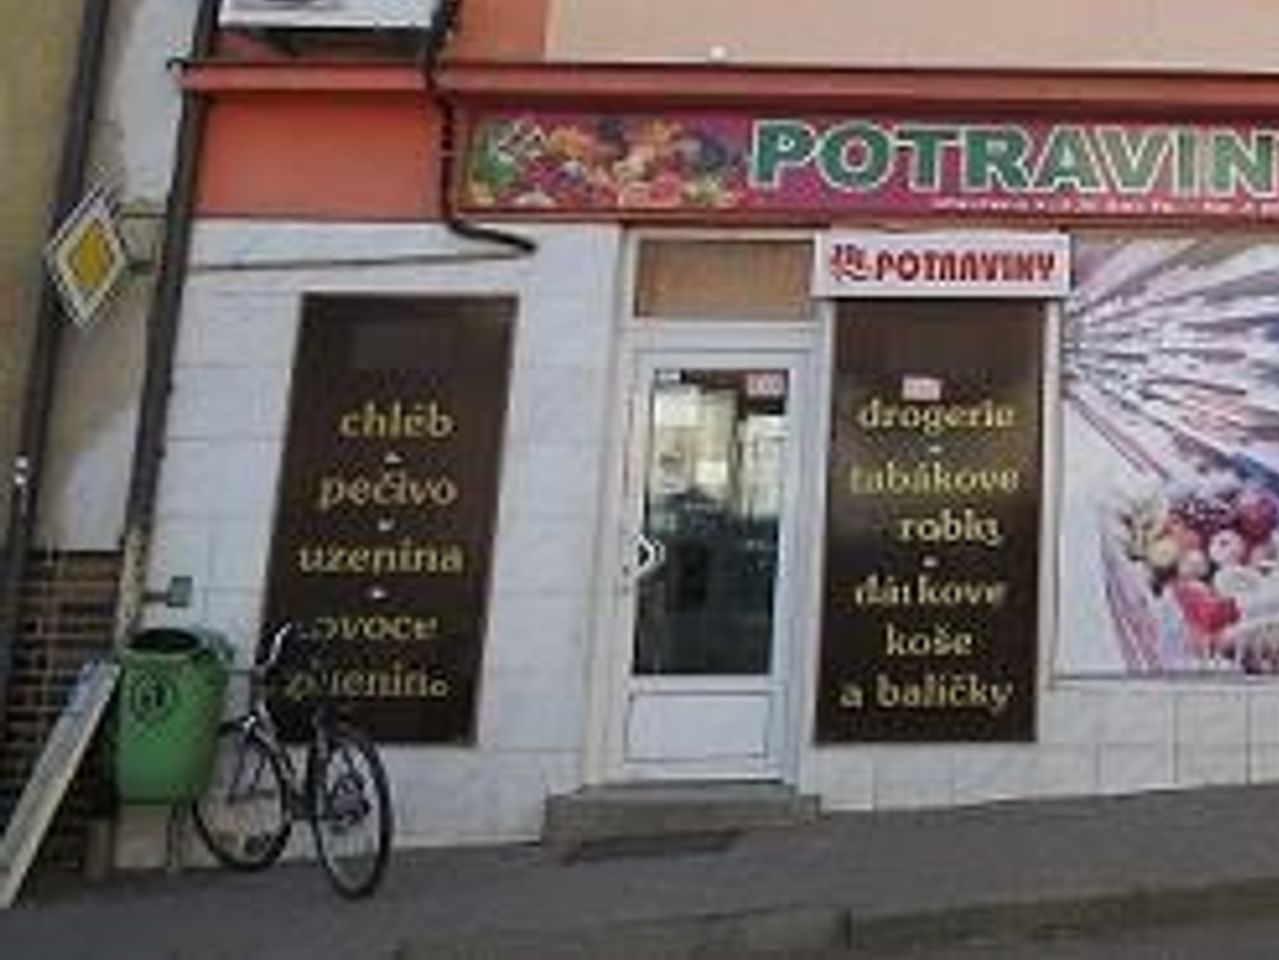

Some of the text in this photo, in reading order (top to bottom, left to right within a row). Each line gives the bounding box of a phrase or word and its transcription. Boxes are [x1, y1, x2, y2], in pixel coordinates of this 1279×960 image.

[876, 249, 1056, 282] POTRAVINY
[858, 399, 1016, 436] drogerie
[298, 537, 465, 575] uzenina
[884, 622, 974, 656] koše
[838, 682, 864, 708] a
